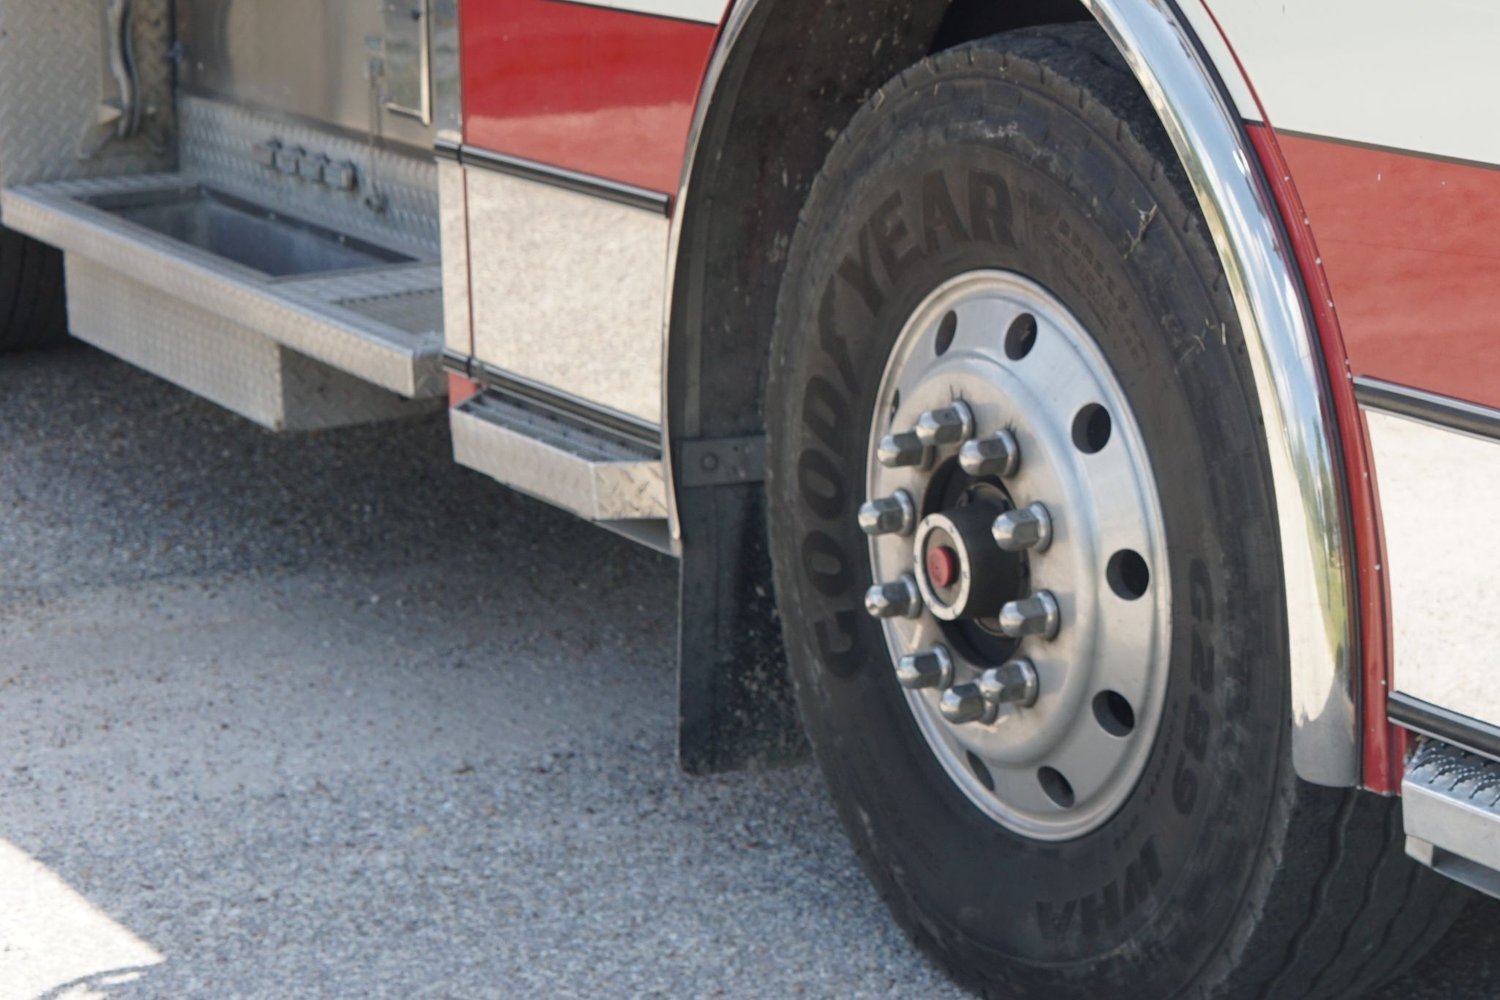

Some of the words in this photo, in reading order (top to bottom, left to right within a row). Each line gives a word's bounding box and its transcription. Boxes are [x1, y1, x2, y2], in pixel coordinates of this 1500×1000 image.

[798, 168, 1018, 679] GOODYEAR
[1172, 558, 1216, 817] G289
[1035, 834, 1163, 940] WHA
